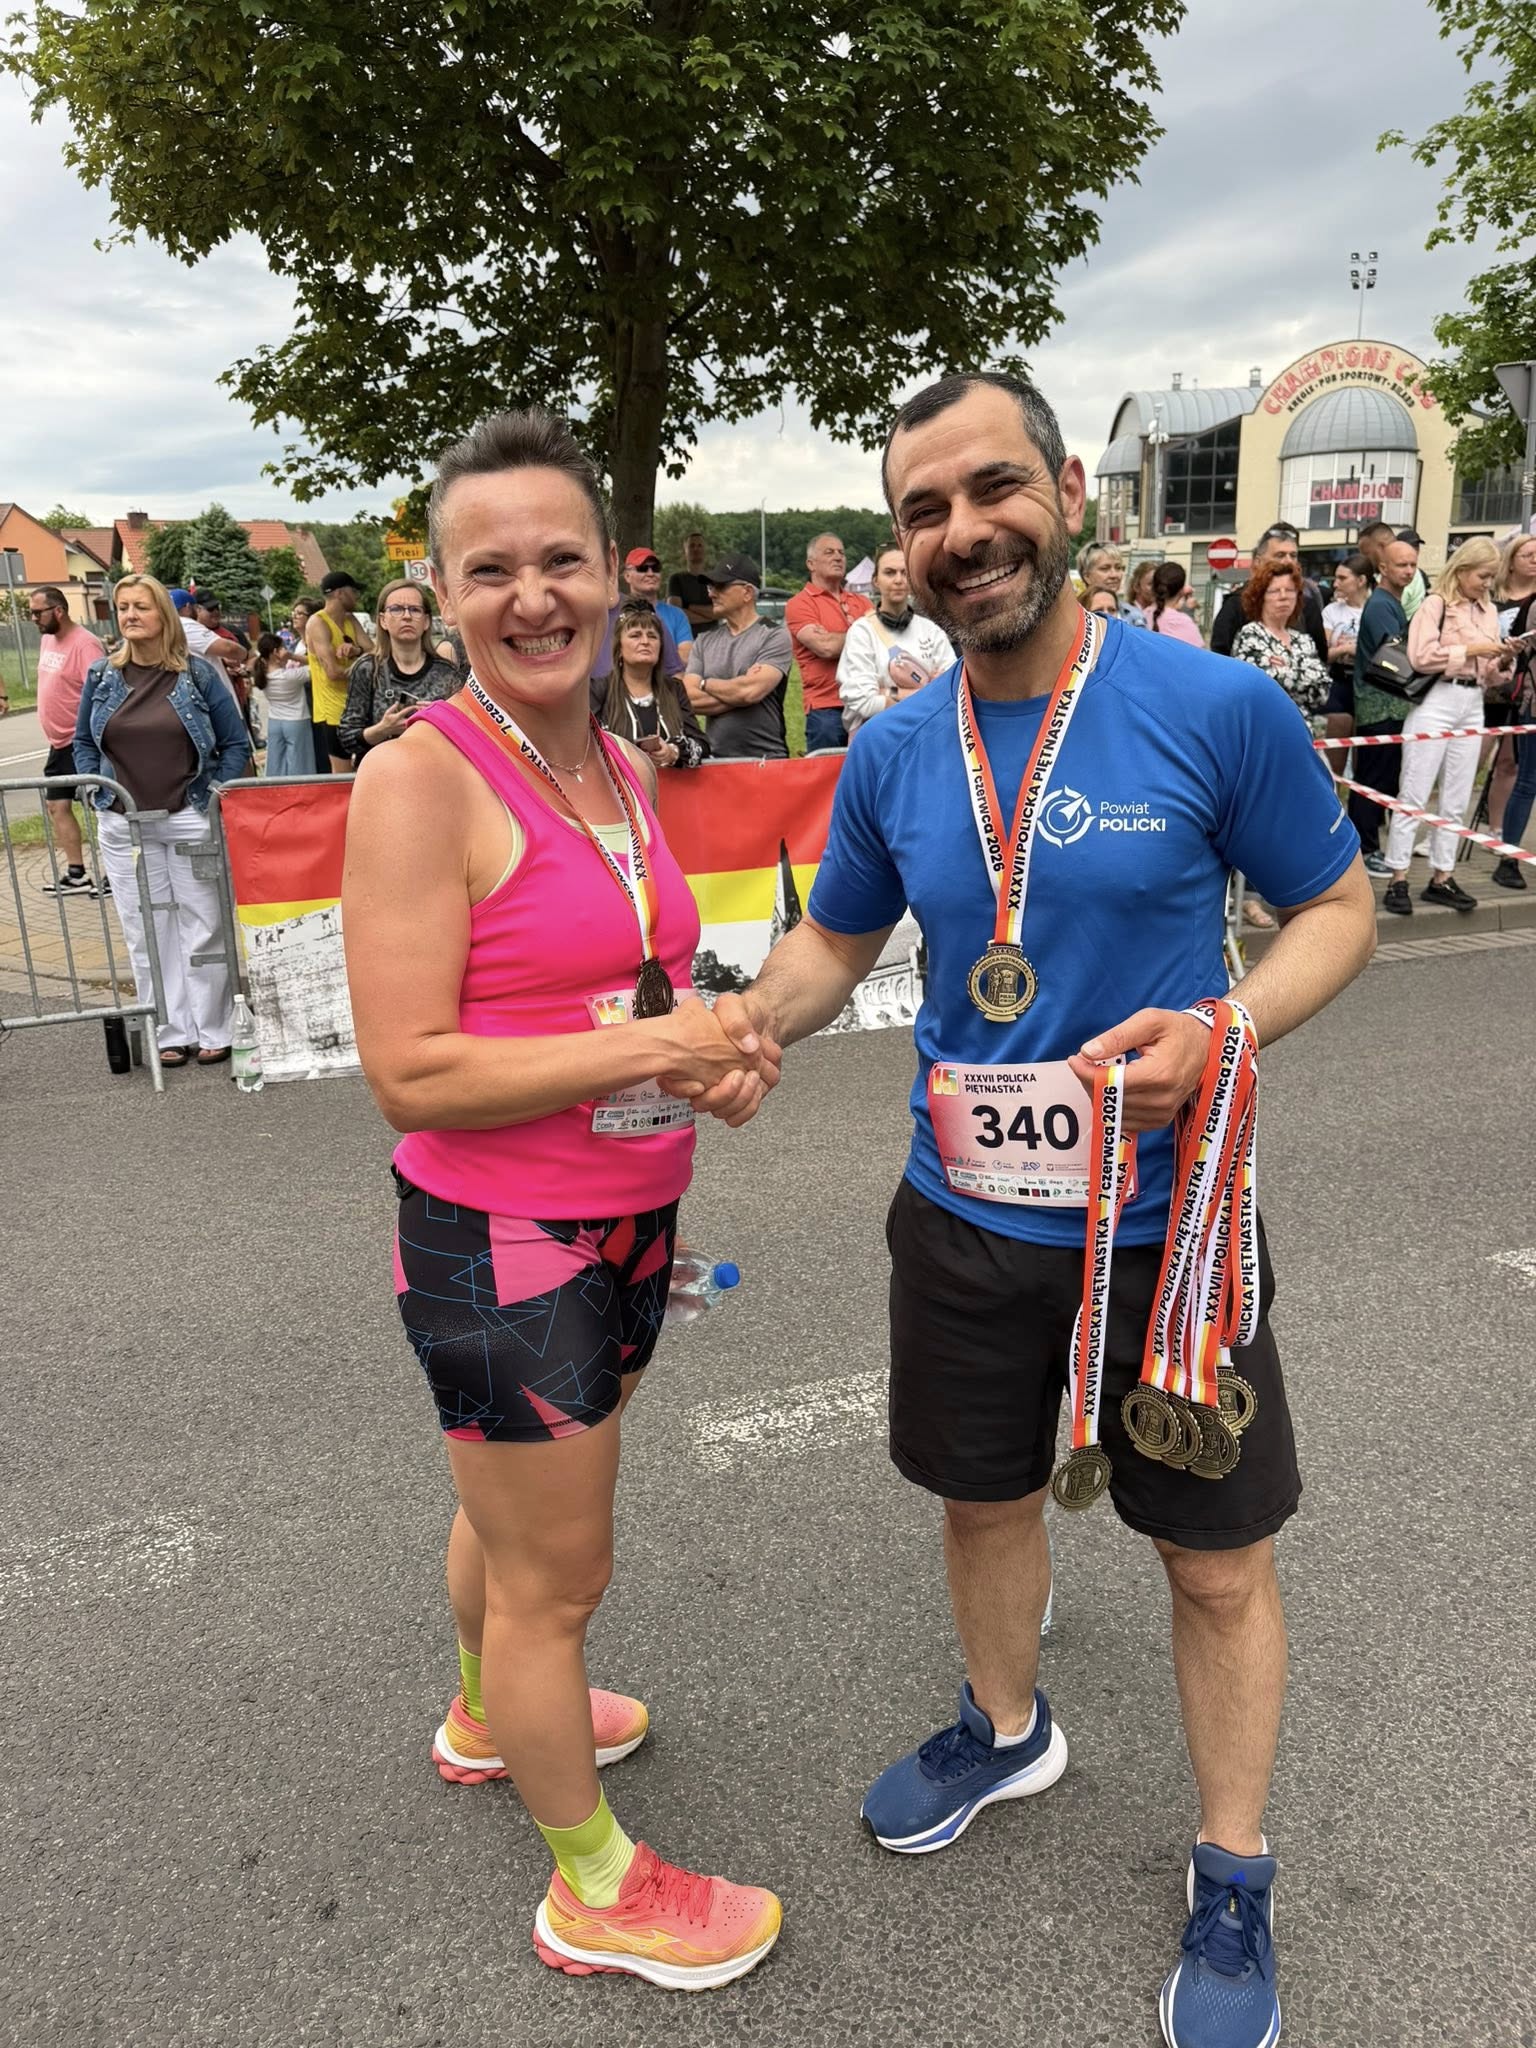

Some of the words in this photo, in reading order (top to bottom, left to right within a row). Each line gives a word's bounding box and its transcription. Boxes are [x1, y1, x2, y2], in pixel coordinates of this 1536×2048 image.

[1340, 371, 1388, 386] SPORTOWY
[1311, 483, 1403, 501] CHAMPIONS
[1338, 502, 1379, 519] CLUB
[395, 547, 419, 557] Piesi
[413, 567, 425, 576] 30
[501, 724, 512, 735] 7
[972, 763, 984, 773] 7
[1007, 854, 1026, 911] XXXVII
[1017, 785, 1041, 854] POLICKA
[1032, 689, 1076, 782] PIĘTNASTKA
[1070, 663, 1084, 674] 7
[974, 774, 994, 834] czerwca
[1100, 801, 1150, 815] Powiat
[1099, 818, 1167, 832] POLICKI
[986, 835, 1005, 873] 2026
[1220, 1025, 1241, 1065] 2026
[964, 1073, 995, 1083] XXXVII
[996, 1073, 1037, 1083] POLICKA
[965, 1084, 1023, 1095] PIĘTNASTKA
[1104, 1085, 1118, 1125] 2026
[1205, 1066, 1233, 1134] czerwca
[971, 1104, 1080, 1151] 340
[1200, 1134, 1213, 1145] 7
[1102, 1126, 1116, 1191] czerwca
[1243, 1160, 1253, 1169] 7
[1098, 1193, 1111, 1202] 7
[1174, 1160, 1207, 1250] PIĘTNASTKA
[1213, 1203, 1233, 1269] POLICKA
[1240, 1186, 1257, 1286] PIĘTNASTKA
[1092, 1217, 1110, 1308] PIĘTNASTKA
[1160, 1250, 1183, 1311] POLICKA
[1172, 1316, 1184, 1367] XXXVII
[1178, 1254, 1194, 1317] POLICKA
[1205, 1271, 1225, 1325] XXXVII
[1233, 1289, 1255, 1347] POLICKA
[1087, 1308, 1103, 1369] POLICKA
[1152, 1309, 1166, 1358] XXXVII
[1083, 1370, 1098, 1417] XXXVII
